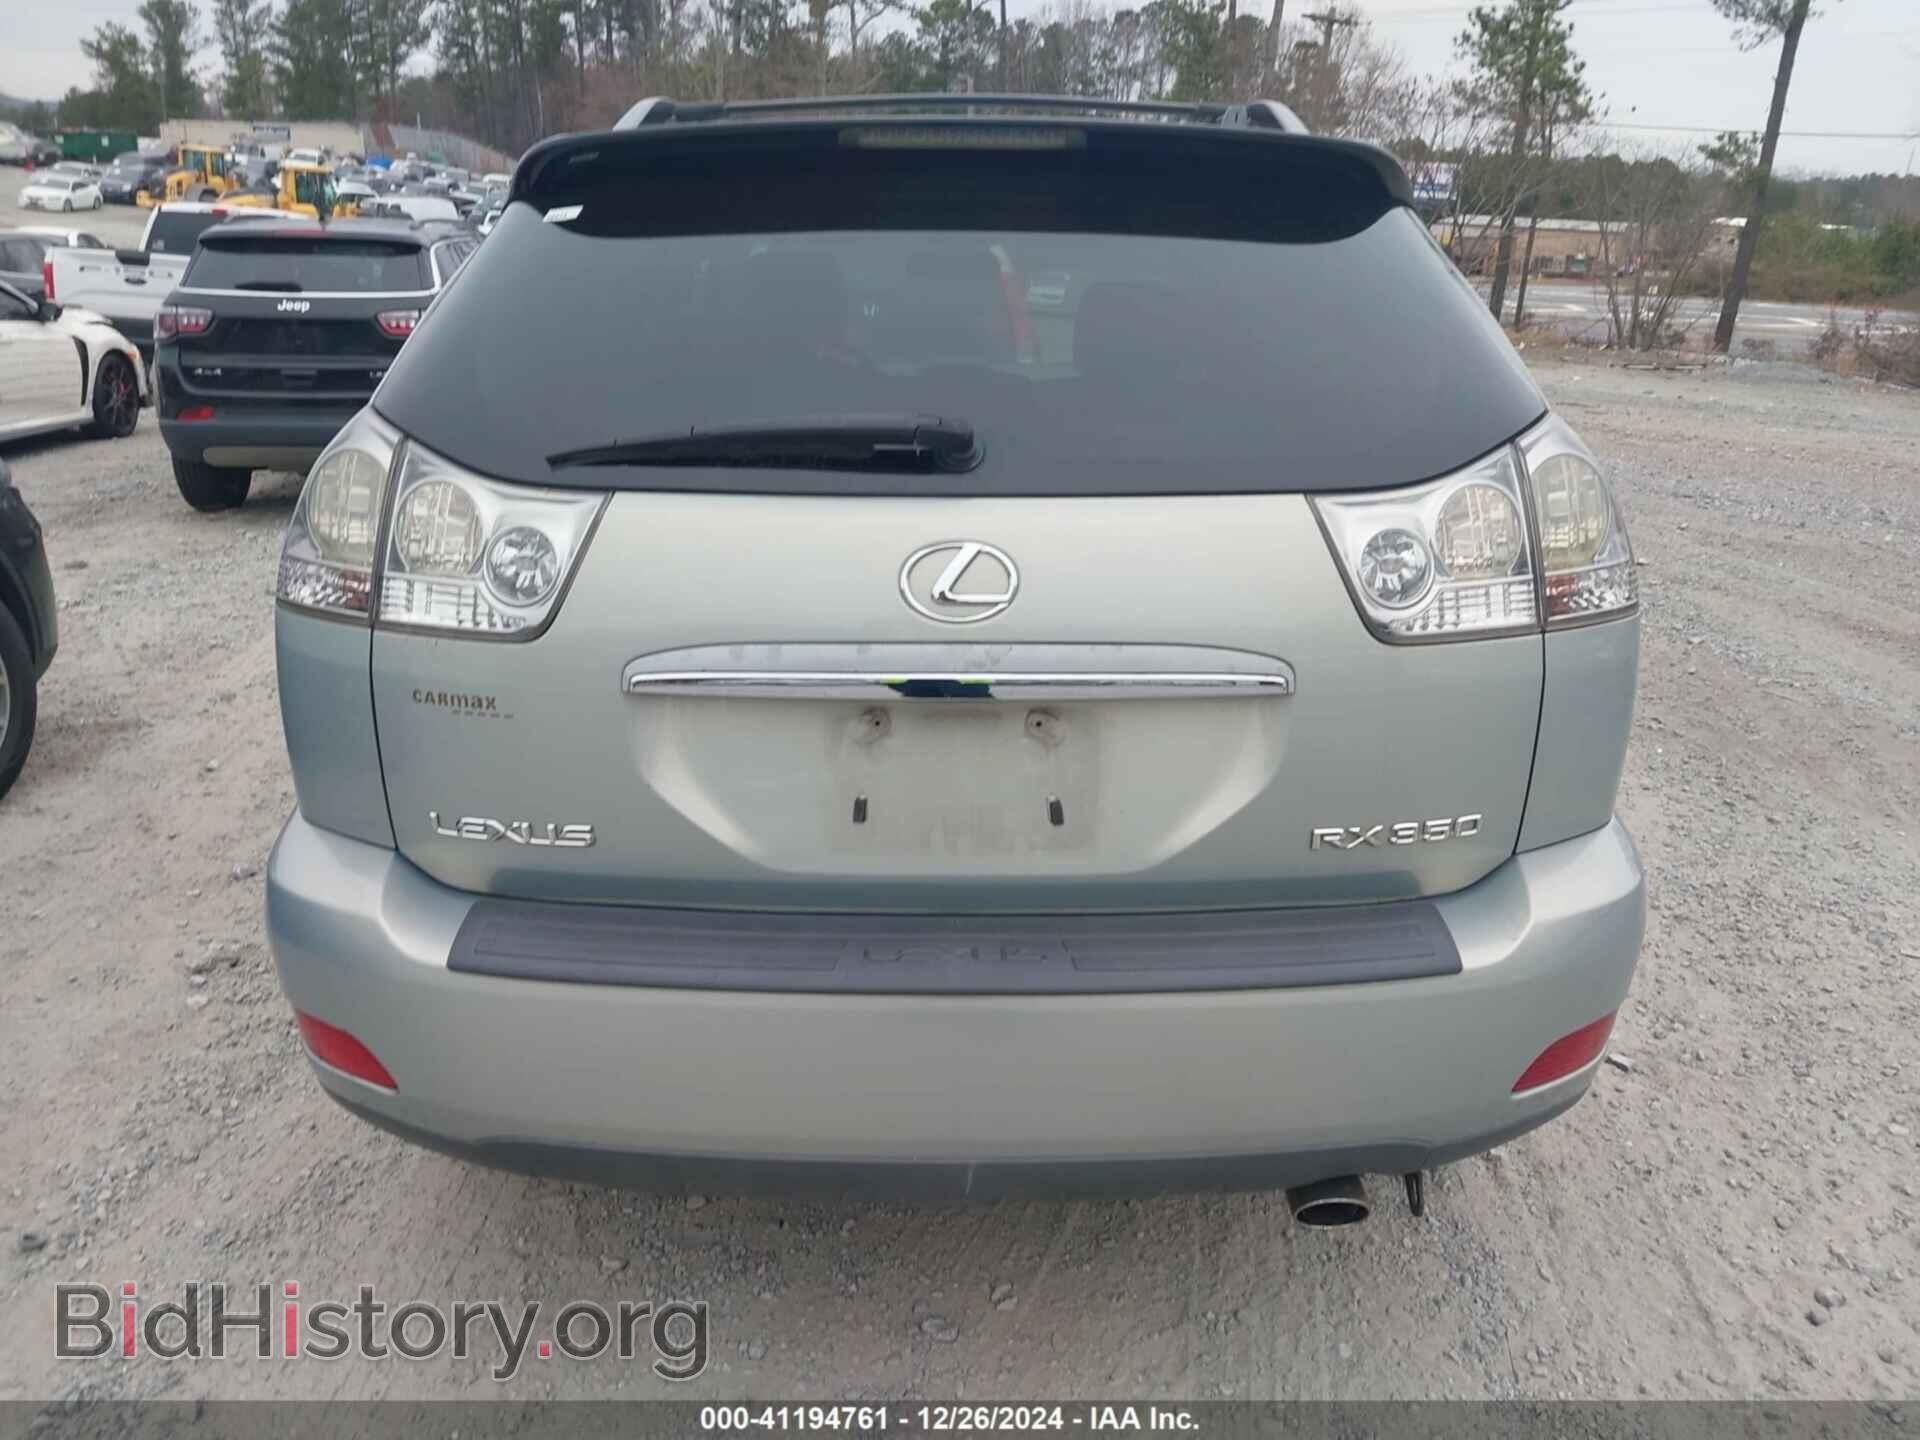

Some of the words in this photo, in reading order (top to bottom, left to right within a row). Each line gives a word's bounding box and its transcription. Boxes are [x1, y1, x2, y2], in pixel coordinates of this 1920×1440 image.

[277, 298, 311, 313] Jeep
[429, 810, 595, 848] LEXUS
[1311, 825, 1384, 850] RX
[1390, 812, 1483, 845] 350
